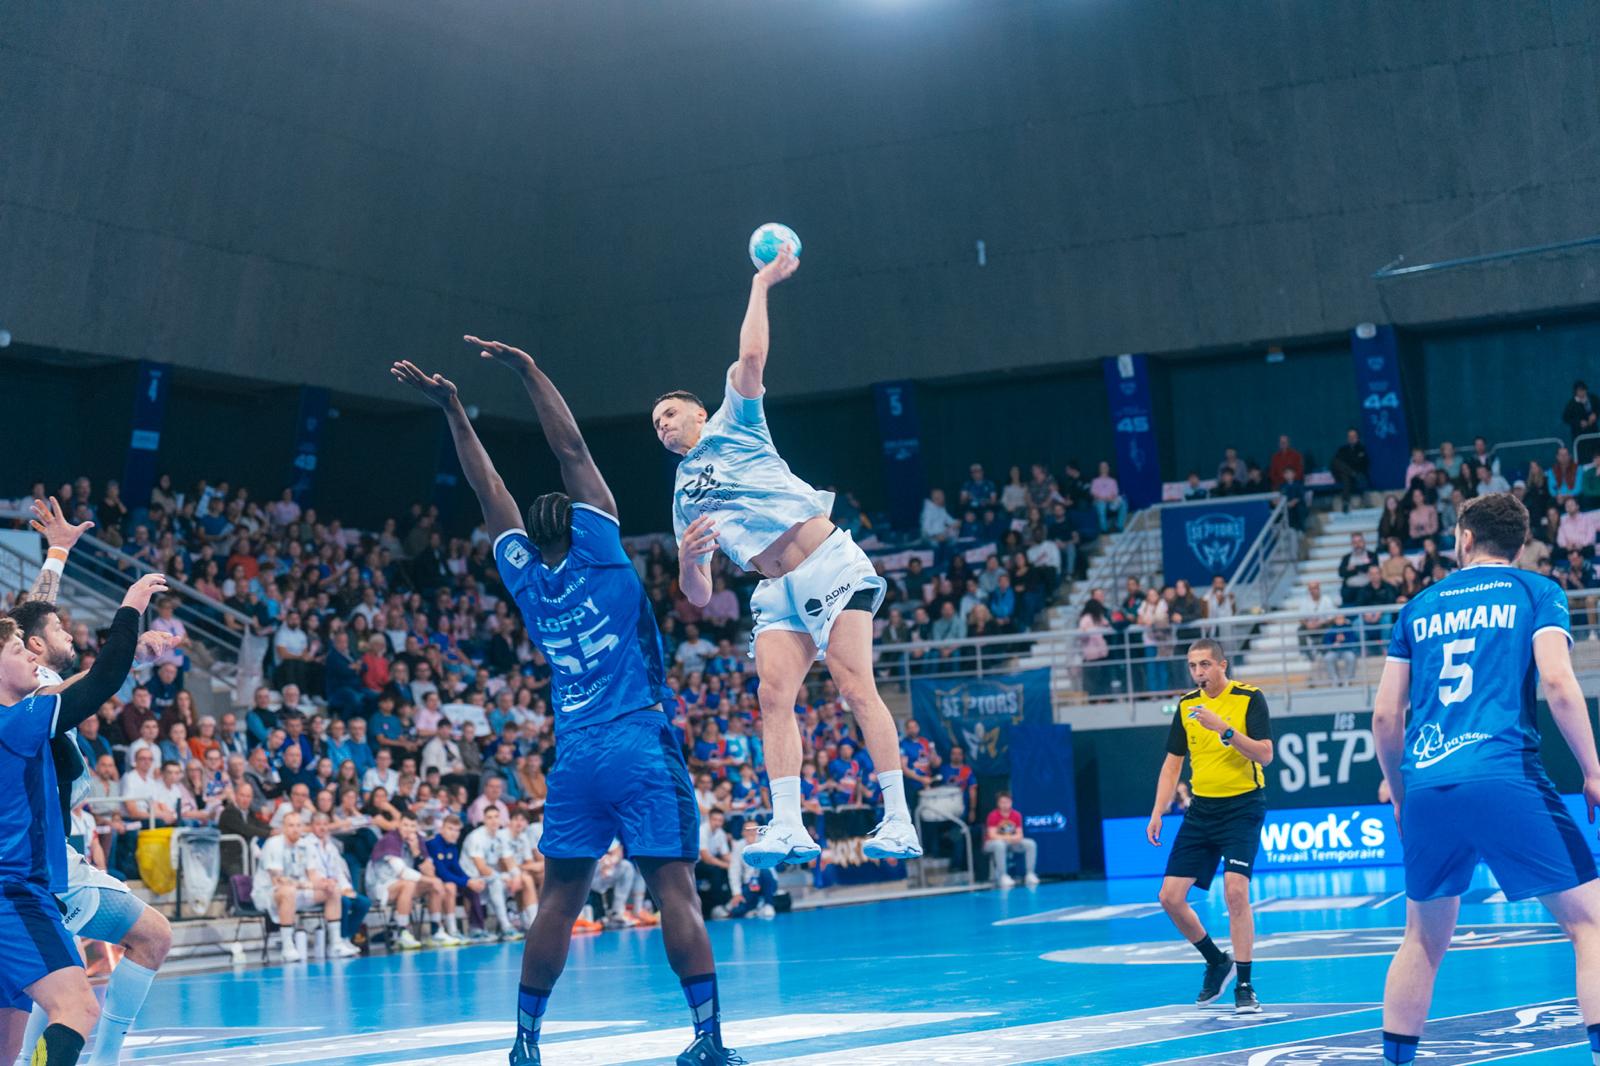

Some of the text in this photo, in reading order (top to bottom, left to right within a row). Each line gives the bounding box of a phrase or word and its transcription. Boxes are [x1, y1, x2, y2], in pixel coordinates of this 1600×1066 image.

[1363, 392, 1400, 410] 44
[1117, 416, 1149, 432] 45
[825, 582, 852, 603] ADIM
[1439, 580, 1513, 598] constellation
[536, 594, 600, 634] LOPPY
[1413, 604, 1517, 644] DAMIANI
[541, 614, 620, 676] 55
[1438, 636, 1476, 707] 5
[1333, 711, 1356, 731] les
[1260, 810, 1385, 851] work's
[1266, 848, 1386, 864] Travail Temporaire
[64, 906, 82, 925] otect
